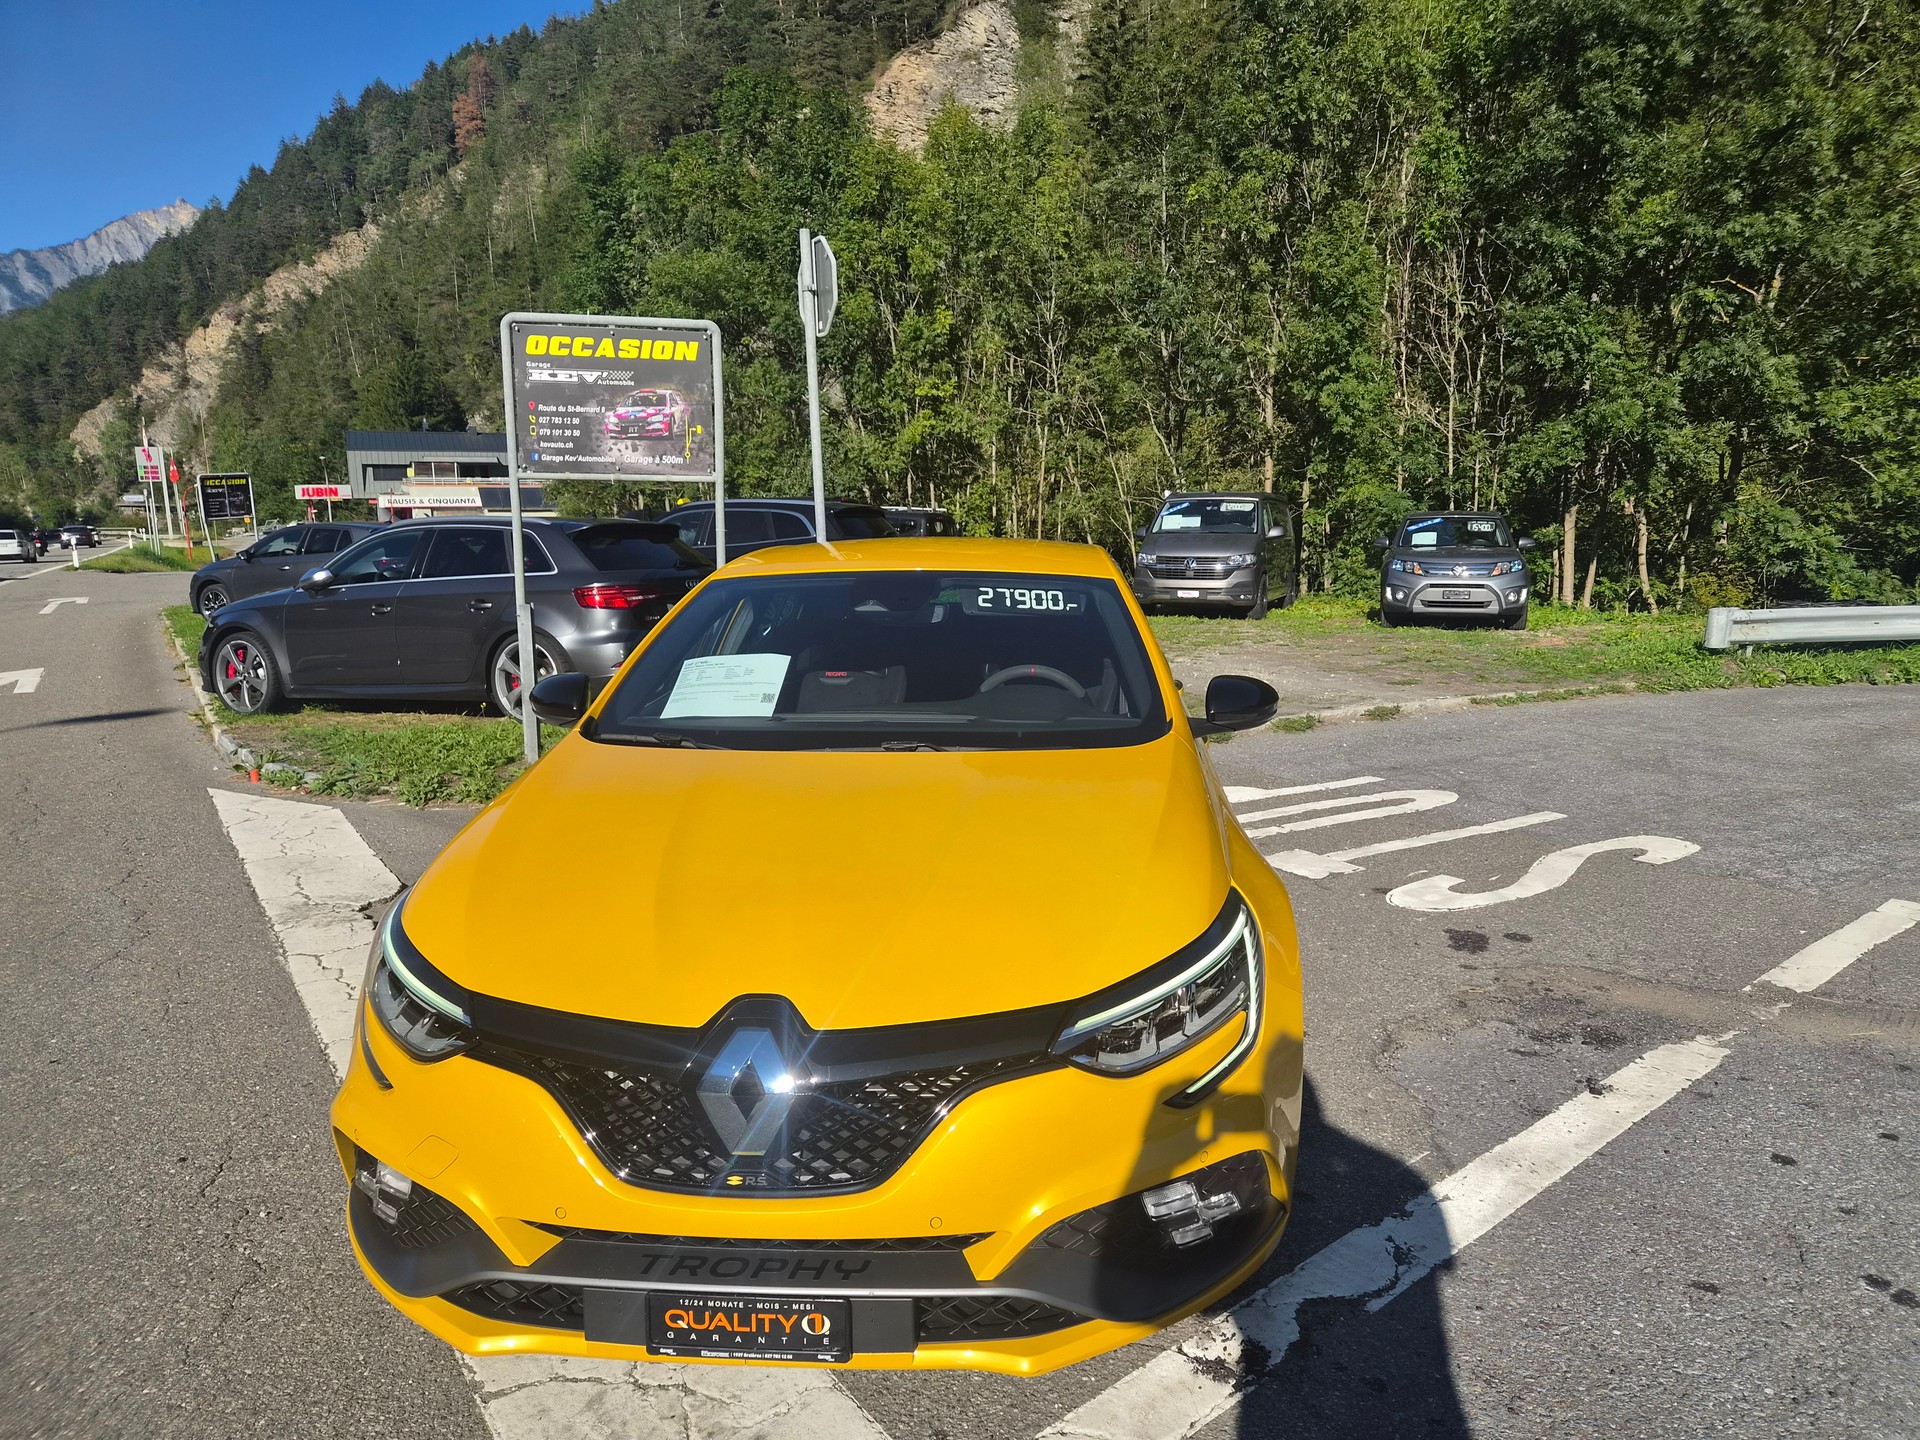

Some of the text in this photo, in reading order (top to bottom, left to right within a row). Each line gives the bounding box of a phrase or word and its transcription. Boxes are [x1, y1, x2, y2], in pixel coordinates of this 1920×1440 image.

[525, 334, 699, 361] OCCASION
[558, 404, 566, 412] du
[567, 405, 600, 413] St-Bernard
[538, 416, 550, 424] 027
[539, 428, 551, 436] 079
[552, 428, 562, 436] 101
[572, 429, 580, 437] 50
[539, 440, 574, 448] kevauto.ch
[541, 454, 616, 463] Garage Kev'Automobiles
[624, 454, 684, 465] Garage à 500m
[204, 478, 246, 486] OCCASION
[301, 487, 339, 497] JUBIN
[640, 1253, 873, 1281] TROPHY
[679, 1299, 704, 1307] 12/24
[707, 1300, 744, 1308] MONATE
[756, 1302, 780, 1310] MOIS
[664, 1308, 798, 1334] QUALITY
[667, 1331, 830, 1345] GARANTIE
